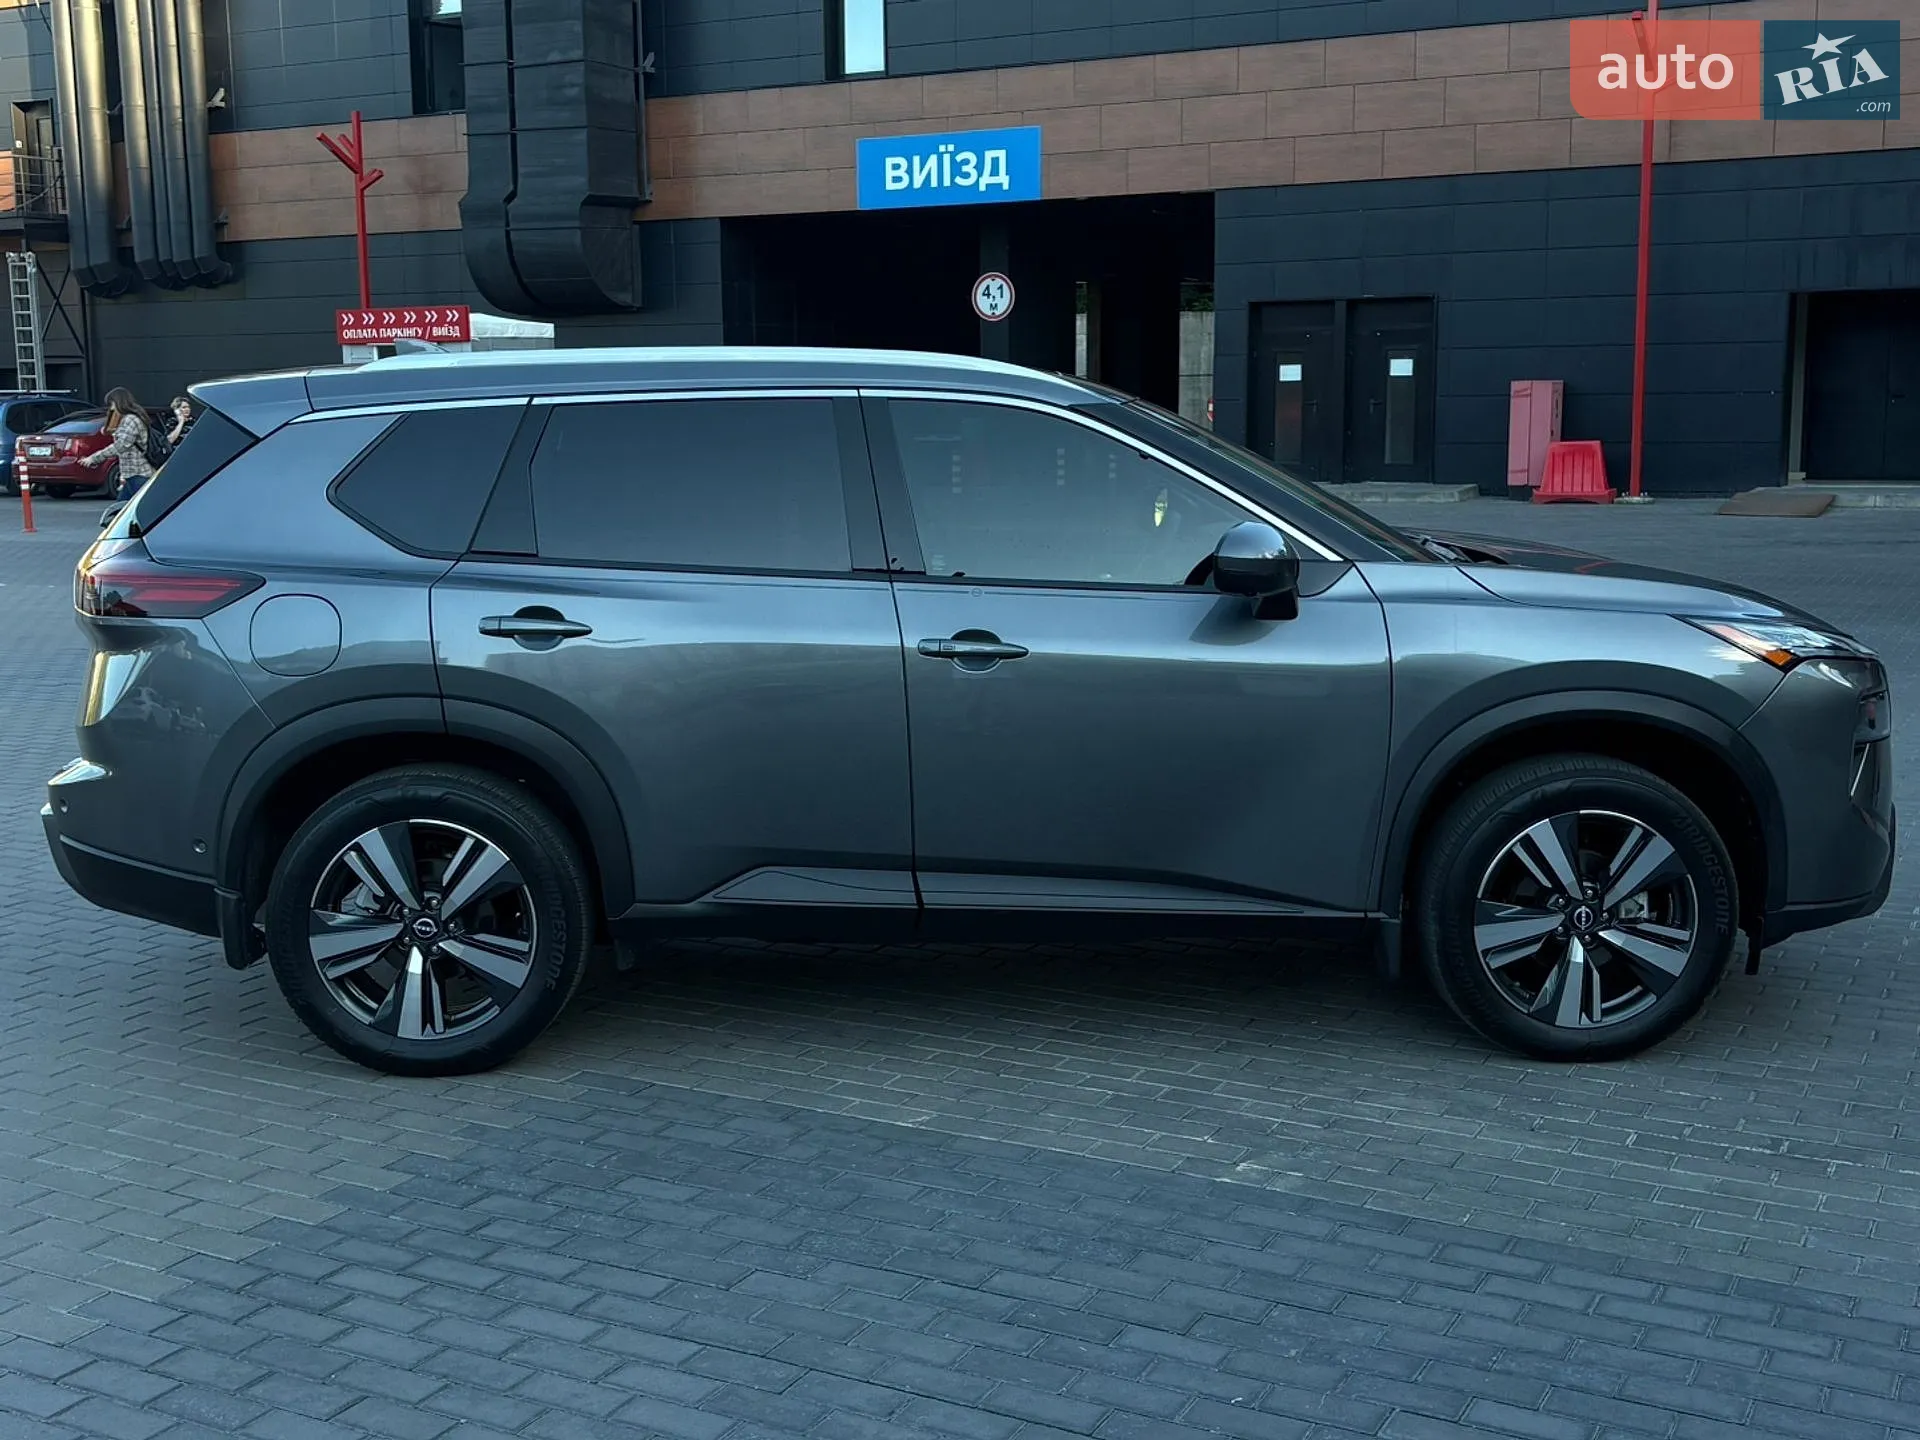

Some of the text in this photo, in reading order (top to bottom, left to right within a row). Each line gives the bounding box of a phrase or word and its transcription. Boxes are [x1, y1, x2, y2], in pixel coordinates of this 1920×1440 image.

[885, 144, 1009, 191] ВИЇЗД
[982, 283, 1004, 301] 4,1
[343, 328, 378, 339] ОПЛАТА
[379, 326, 423, 338] ПАРКІНГУ
[432, 324, 460, 337] ВИЇЗД
